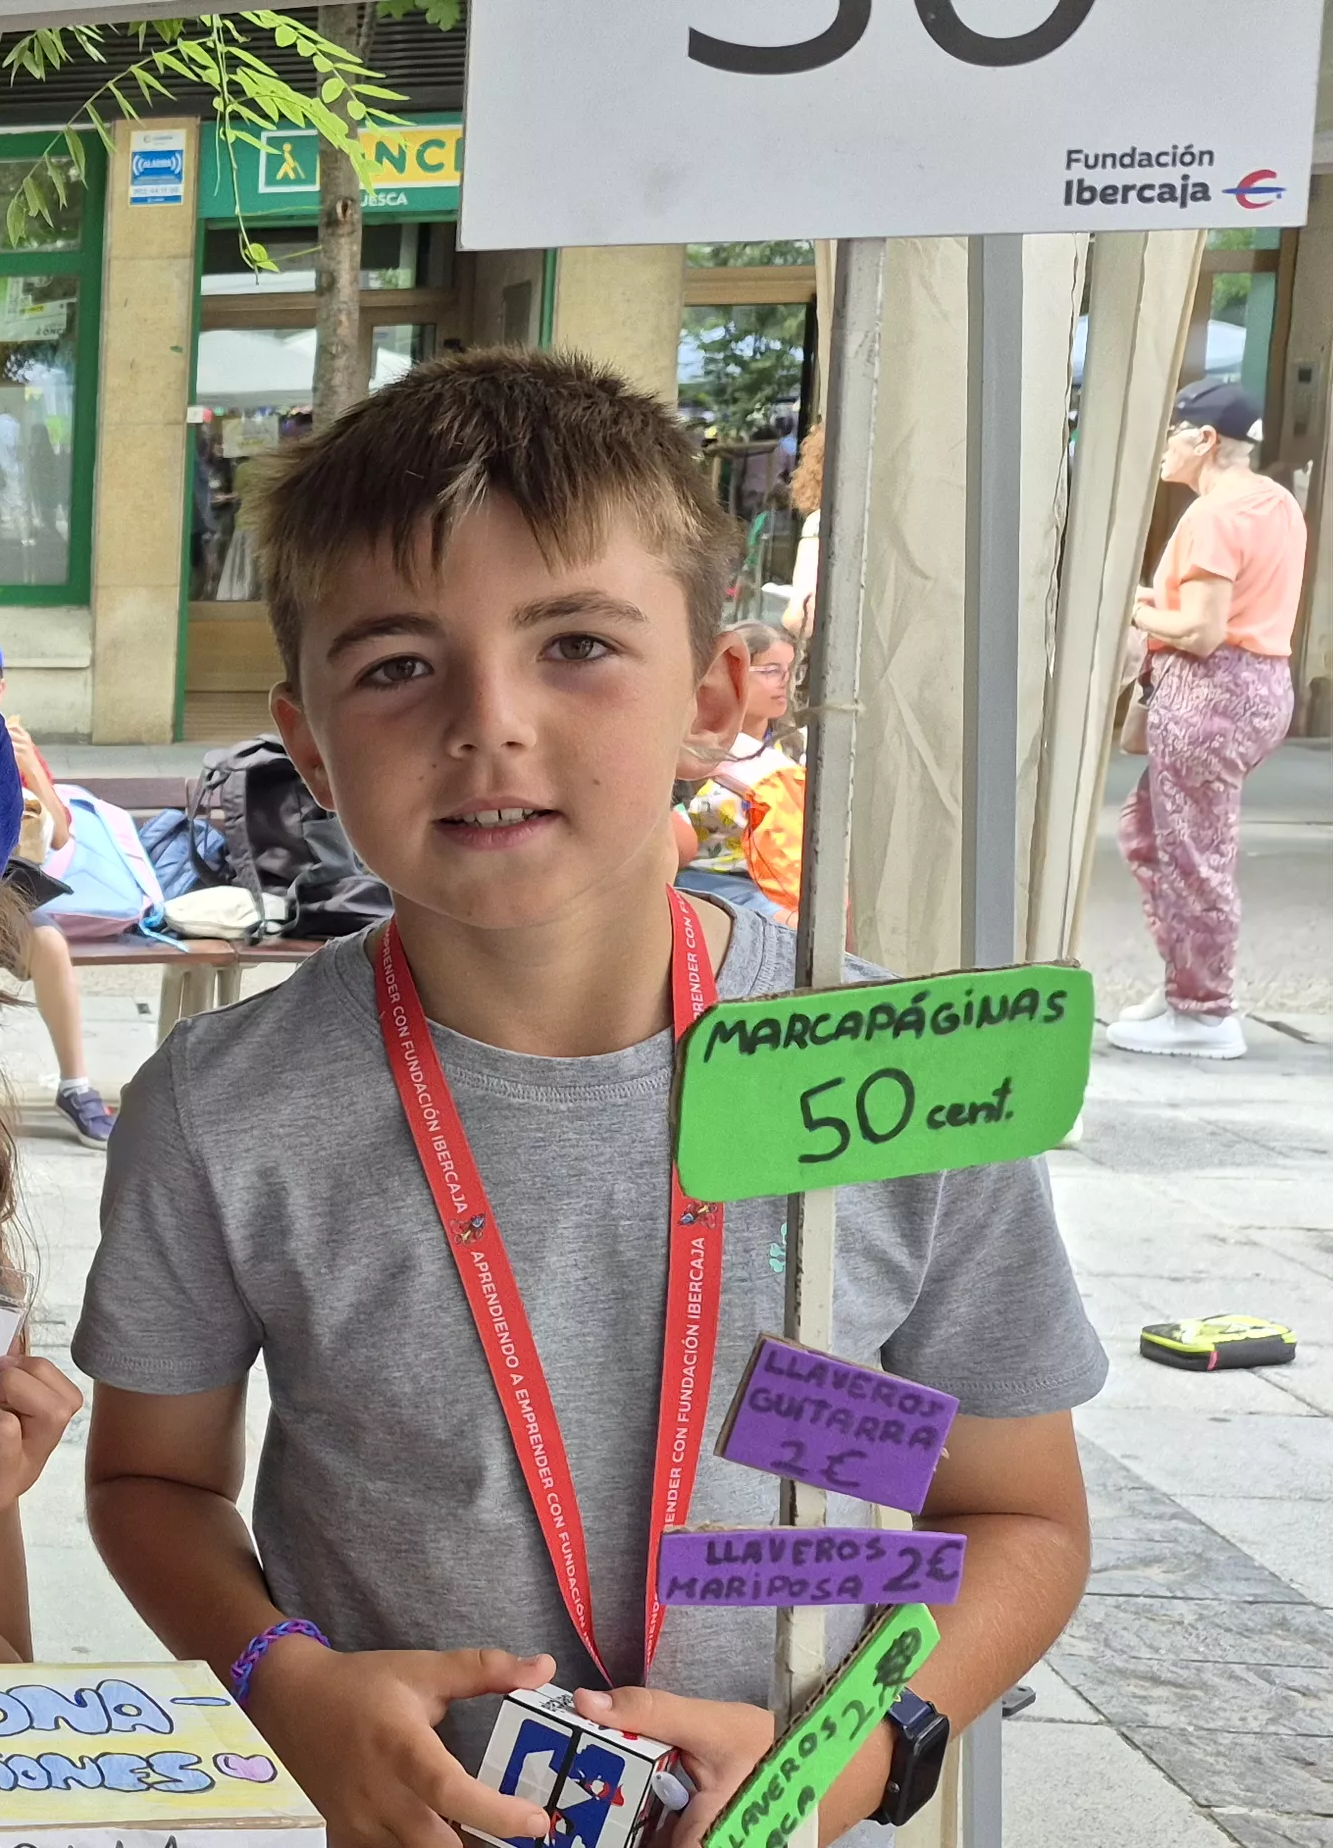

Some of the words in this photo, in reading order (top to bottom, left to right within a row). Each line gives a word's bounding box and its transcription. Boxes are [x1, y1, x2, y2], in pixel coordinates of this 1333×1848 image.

[1064, 144, 1216, 171] Fundación
[1064, 174, 1212, 209] Ibercaja
[684, 917, 696, 948] CON
[392, 1006, 410, 1040] CON
[401, 1040, 440, 1132] FUNDACIÓN
[432, 1134, 468, 1215] IBERCAJA
[798, 1067, 916, 1164] 50
[925, 1075, 1014, 1130] cent.
[470, 1250, 519, 1368] APRENDIENDO
[688, 1236, 705, 1318] IBERCAJA
[510, 1372, 524, 1386] A
[678, 1321, 700, 1424] FUNDACIÓN
[763, 1350, 945, 1418] LLAVEROS
[514, 1388, 553, 1490] EMPRENDER
[671, 1426, 687, 1462] CON
[748, 1386, 938, 1450] GUITARRA
[546, 1492, 565, 1528] CON
[558, 1532, 588, 1631] FUNDACIÓN
[706, 1536, 886, 1566] LLAVEROS
[666, 1573, 864, 1601] MARIPOSA
[728, 1716, 837, 1848] LAVEROS
